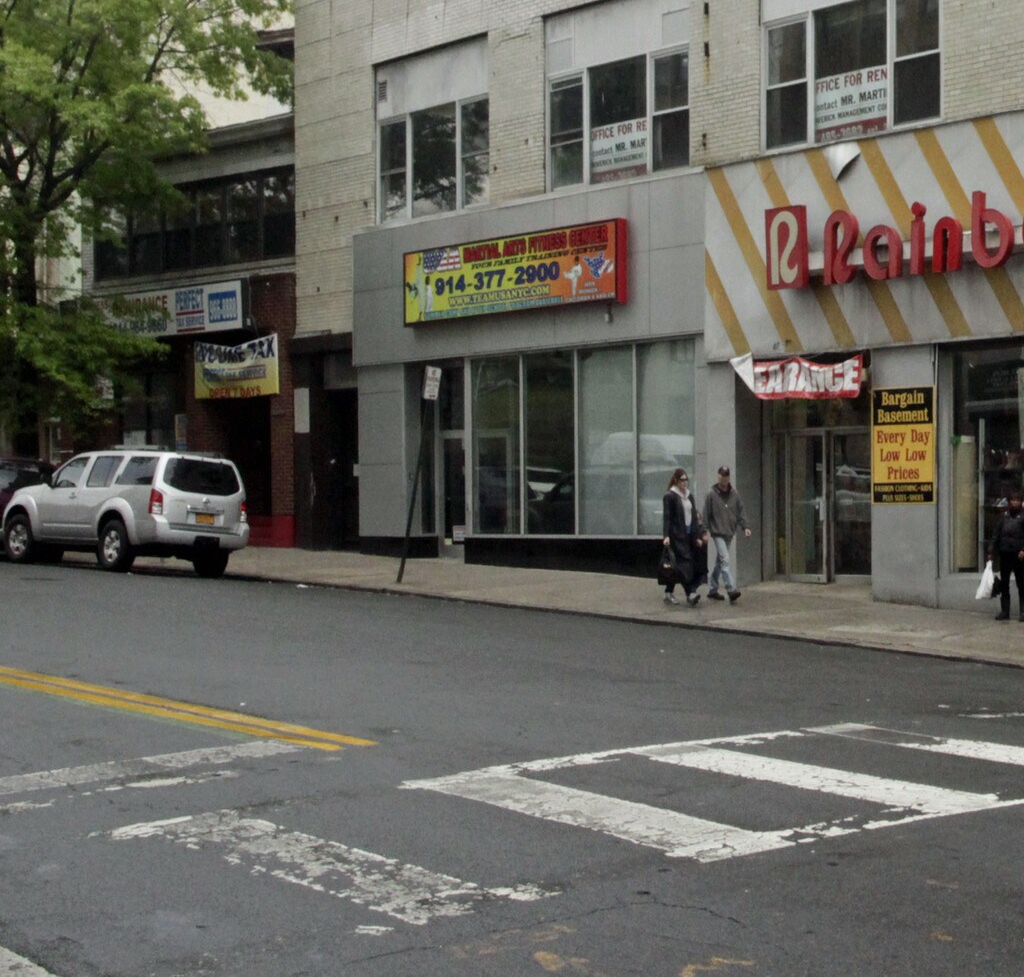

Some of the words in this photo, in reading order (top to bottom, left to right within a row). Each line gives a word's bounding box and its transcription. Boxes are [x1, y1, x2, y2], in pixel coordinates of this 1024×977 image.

[815, 78, 840, 95] FFICE
[844, 73, 862, 88] FOR
[867, 68, 887, 82] REN
[837, 105, 876, 119] MANAGEMENT
[618, 123, 633, 135] FOR
[463, 242, 501, 263] MARTIAL
[502, 238, 527, 258] ARTS
[528, 231, 568, 254] FITNESS
[569, 225, 608, 248] CENTER
[435, 261, 560, 296] 914-377-2900
[175, 288, 204, 310] PERFECT
[247, 336, 275, 360] TAX
[754, 359, 860, 394] EARANCE
[240, 386, 262, 398] DAYS
[881, 390, 925, 408] Bargain
[877, 408, 929, 423] Basement
[876, 430, 906, 446] Every
[911, 429, 931, 445] Day
[880, 448, 900, 462] Low
[905, 448, 927, 462] Low
[887, 466, 920, 480] Prices
